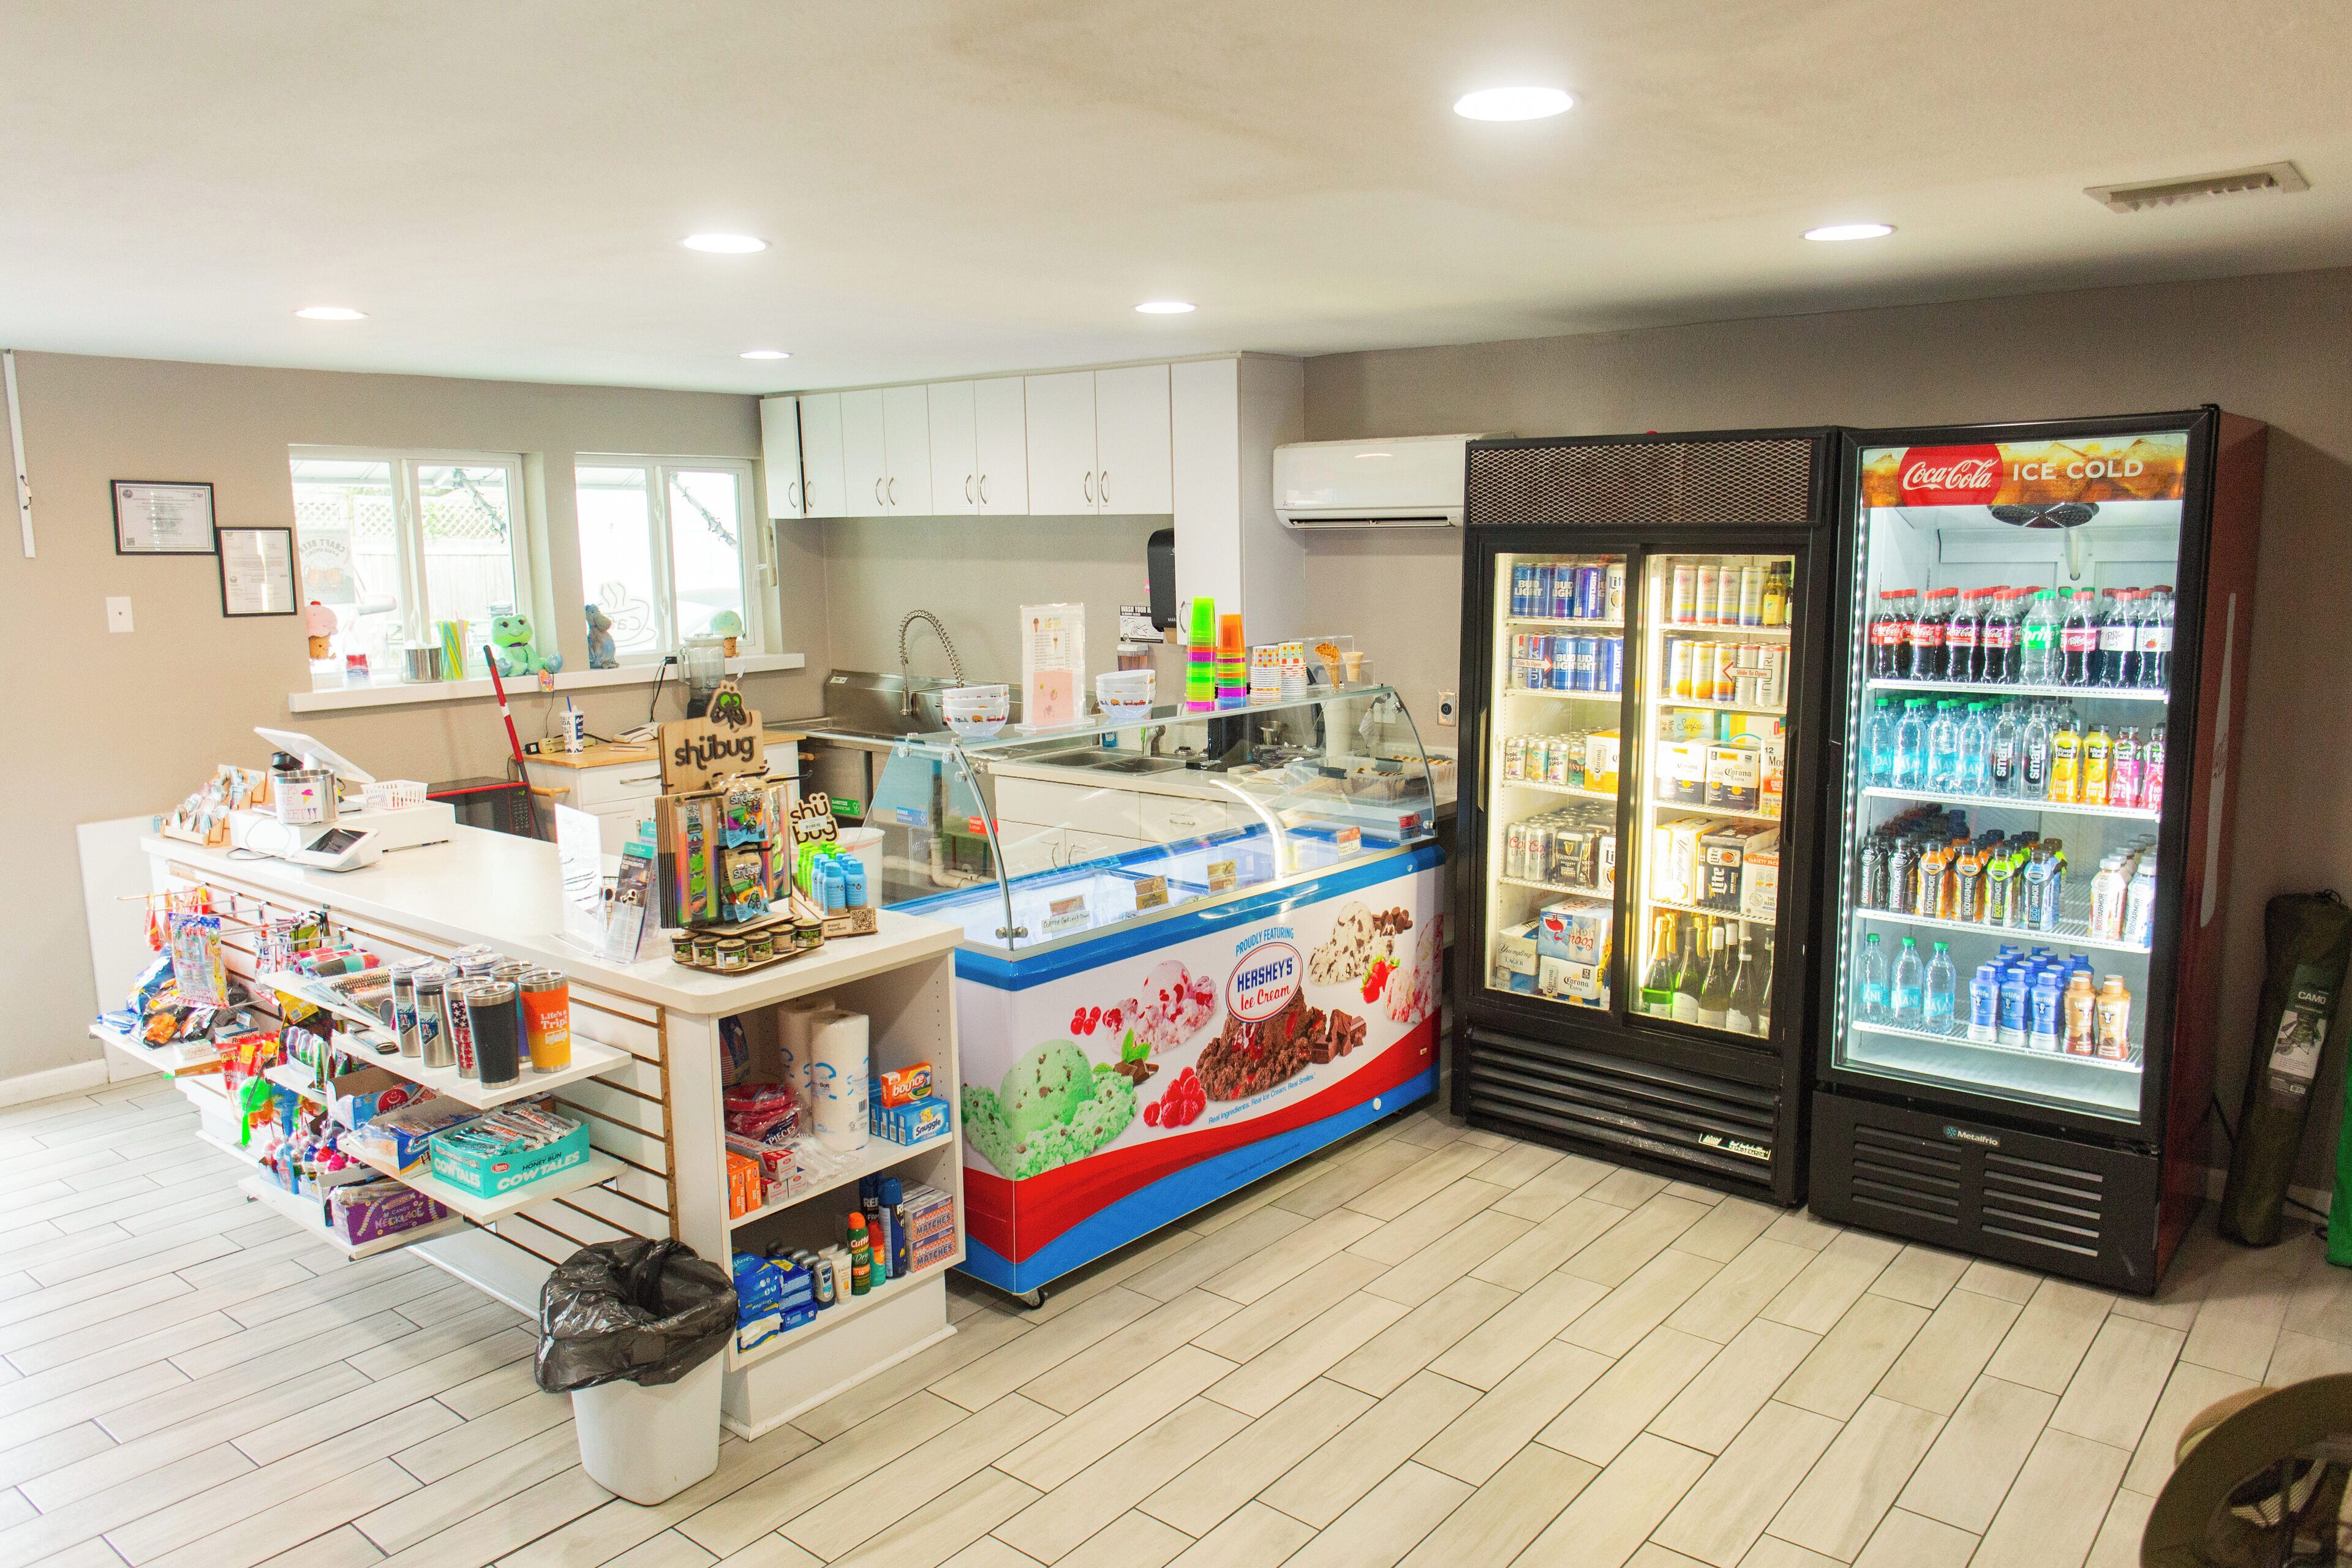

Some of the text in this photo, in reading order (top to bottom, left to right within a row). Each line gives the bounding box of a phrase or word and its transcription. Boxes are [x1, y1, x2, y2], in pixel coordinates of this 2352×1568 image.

[1902, 458, 1998, 490] Coca-Cola
[2013, 459, 2144, 481] ICE COLD
[1514, 587, 1543, 596] LIGHT
[1518, 579, 1539, 588] BUD
[1552, 589, 1574, 597] LIGH
[1872, 624, 1901, 636] Coca-Cola
[1556, 654, 1576, 662] BUD
[1997, 740, 2008, 777] smart
[2029, 744, 2041, 780] smart
[1724, 767, 1752, 777] Corona
[1605, 850, 1614, 864] Li
[1711, 867, 1727, 895] Lite
[1892, 869, 1902, 908] BODYARMOR
[1926, 875, 1936, 914] BODYARMOR
[1963, 877, 1973, 916] BODYARMOR
[1993, 881, 2002, 918] BODYARMOR
[2031, 884, 2040, 922] BODYARMOR
[2096, 893, 2105, 930] BODYARMOR
[2128, 898, 2140, 935] BODYARMOR
[1235, 927, 1294, 957] PROUDLY FEATURING
[1500, 943, 1533, 959] Yuengling
[1505, 957, 1524, 966] LAGER
[1237, 957, 1293, 993] HERSHEY'S
[1564, 976, 1589, 988] Corona
[1241, 985, 1291, 1011] Ice Cream
[2298, 991, 2326, 1005] CAMO
[540, 1011, 563, 1020] Life's
[540, 1016, 568, 1029] Trip!
[893, 1074, 925, 1097] bounce
[1208, 1114, 1220, 1125] Real
[1221, 1103, 1250, 1120] Ingredients.
[1251, 1096, 1262, 1106] Real
[1287, 1081, 1298, 1090] Real
[769, 1124, 796, 1145] PIECES
[916, 1118, 941, 1136] Snuggle
[1958, 1131, 1998, 1145] Metalfrio
[522, 1152, 562, 1171] HONEY BUN
[1728, 1145, 1765, 1157] REFRIGERATOR
[434, 1158, 457, 1177] COW
[456, 1164, 481, 1188] TALES
[497, 1170, 538, 1191] COW
[540, 1150, 580, 1175] TALES
[375, 1207, 424, 1229] NECKLACE
[392, 1205, 410, 1215] CANDY
[916, 1214, 951, 1235] MATCHES
[853, 1253, 869, 1264] Dry
[916, 1243, 953, 1265] MATCHES
